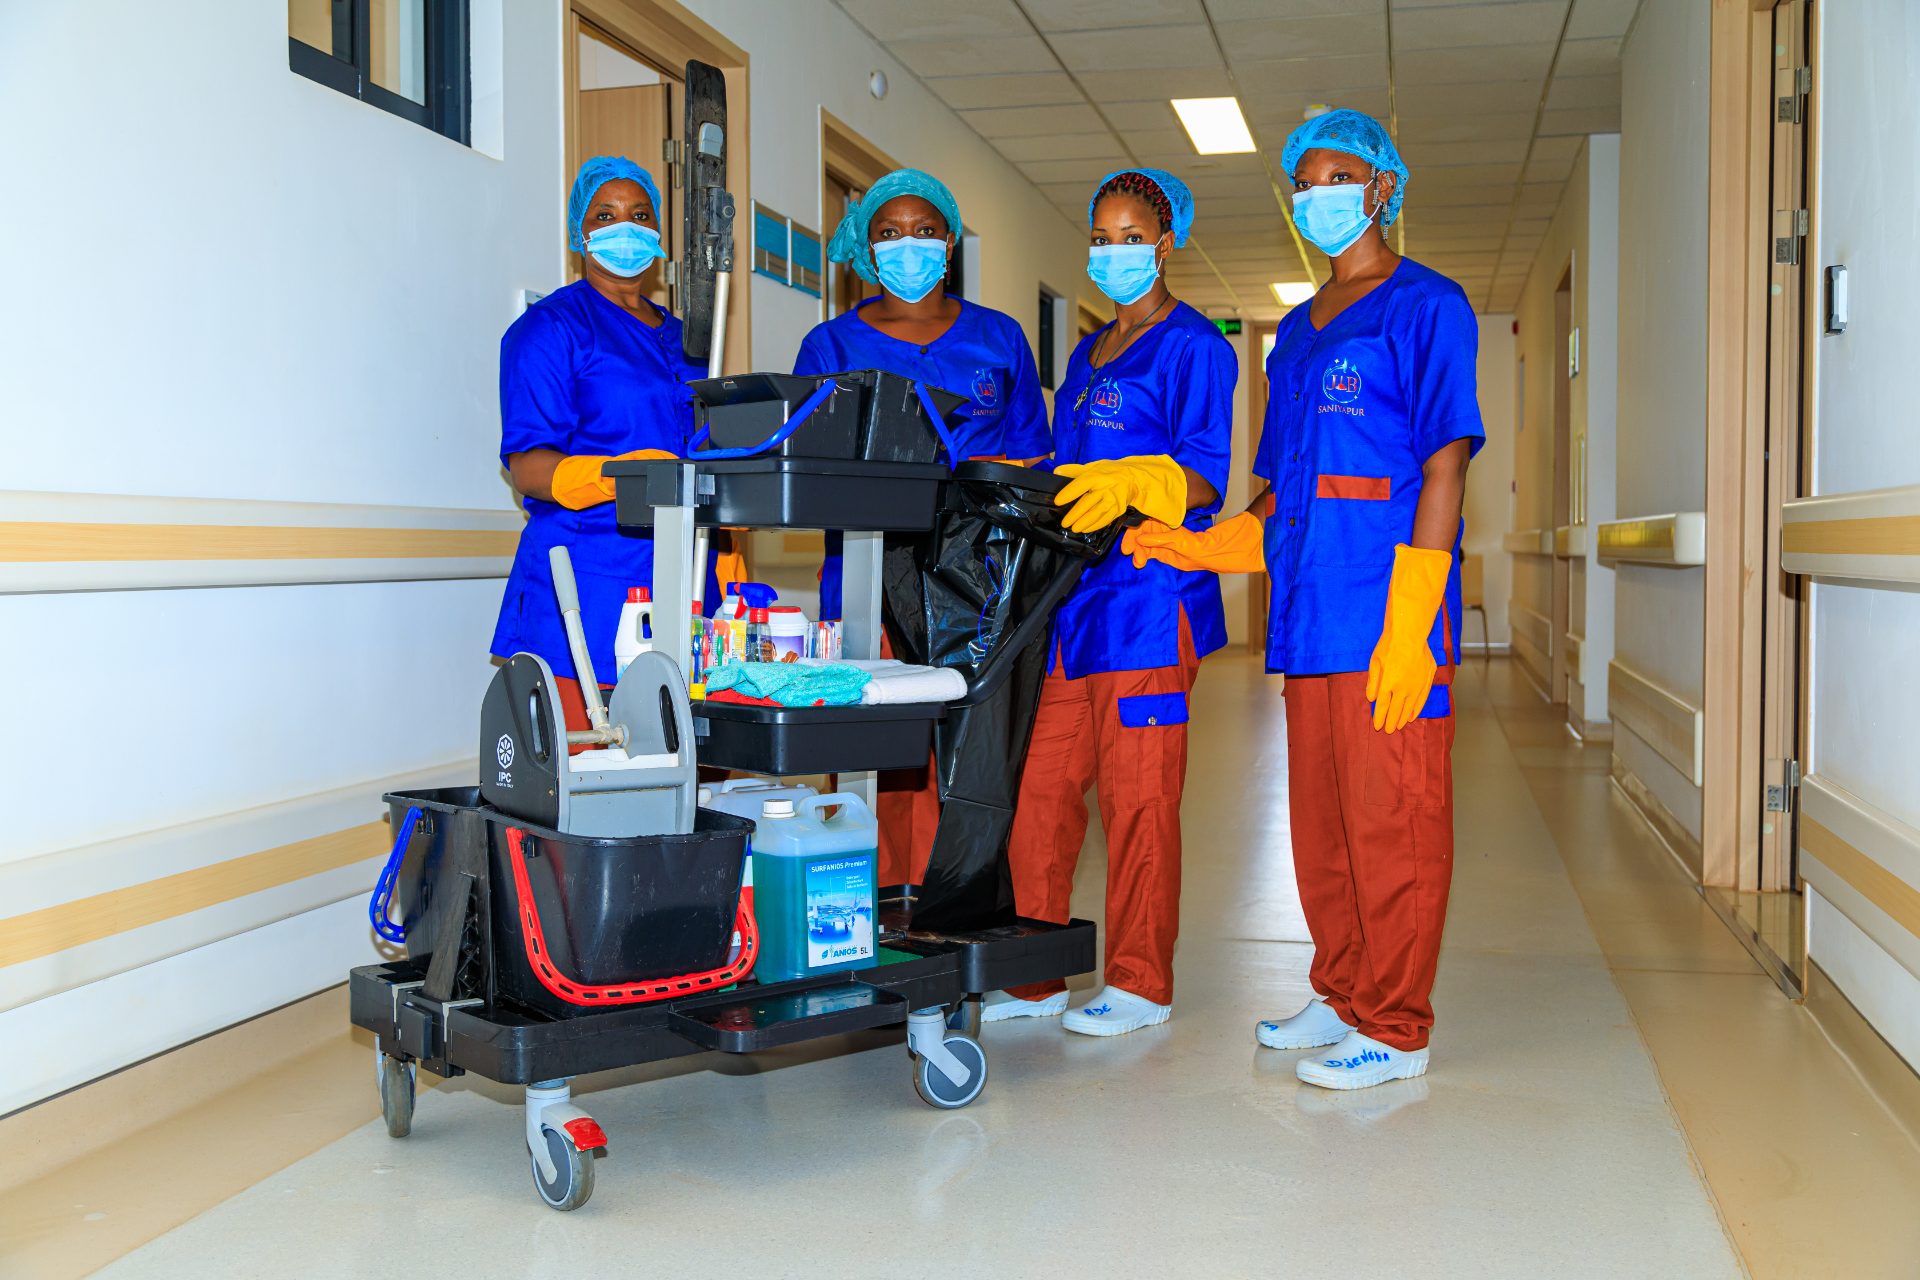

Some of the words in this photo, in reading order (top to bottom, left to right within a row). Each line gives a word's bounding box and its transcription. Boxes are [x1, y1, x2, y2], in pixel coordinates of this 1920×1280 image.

[498, 771, 512, 783] IPC
[811, 862, 844, 873] SURFANIOS
[844, 860, 868, 869] Premium
